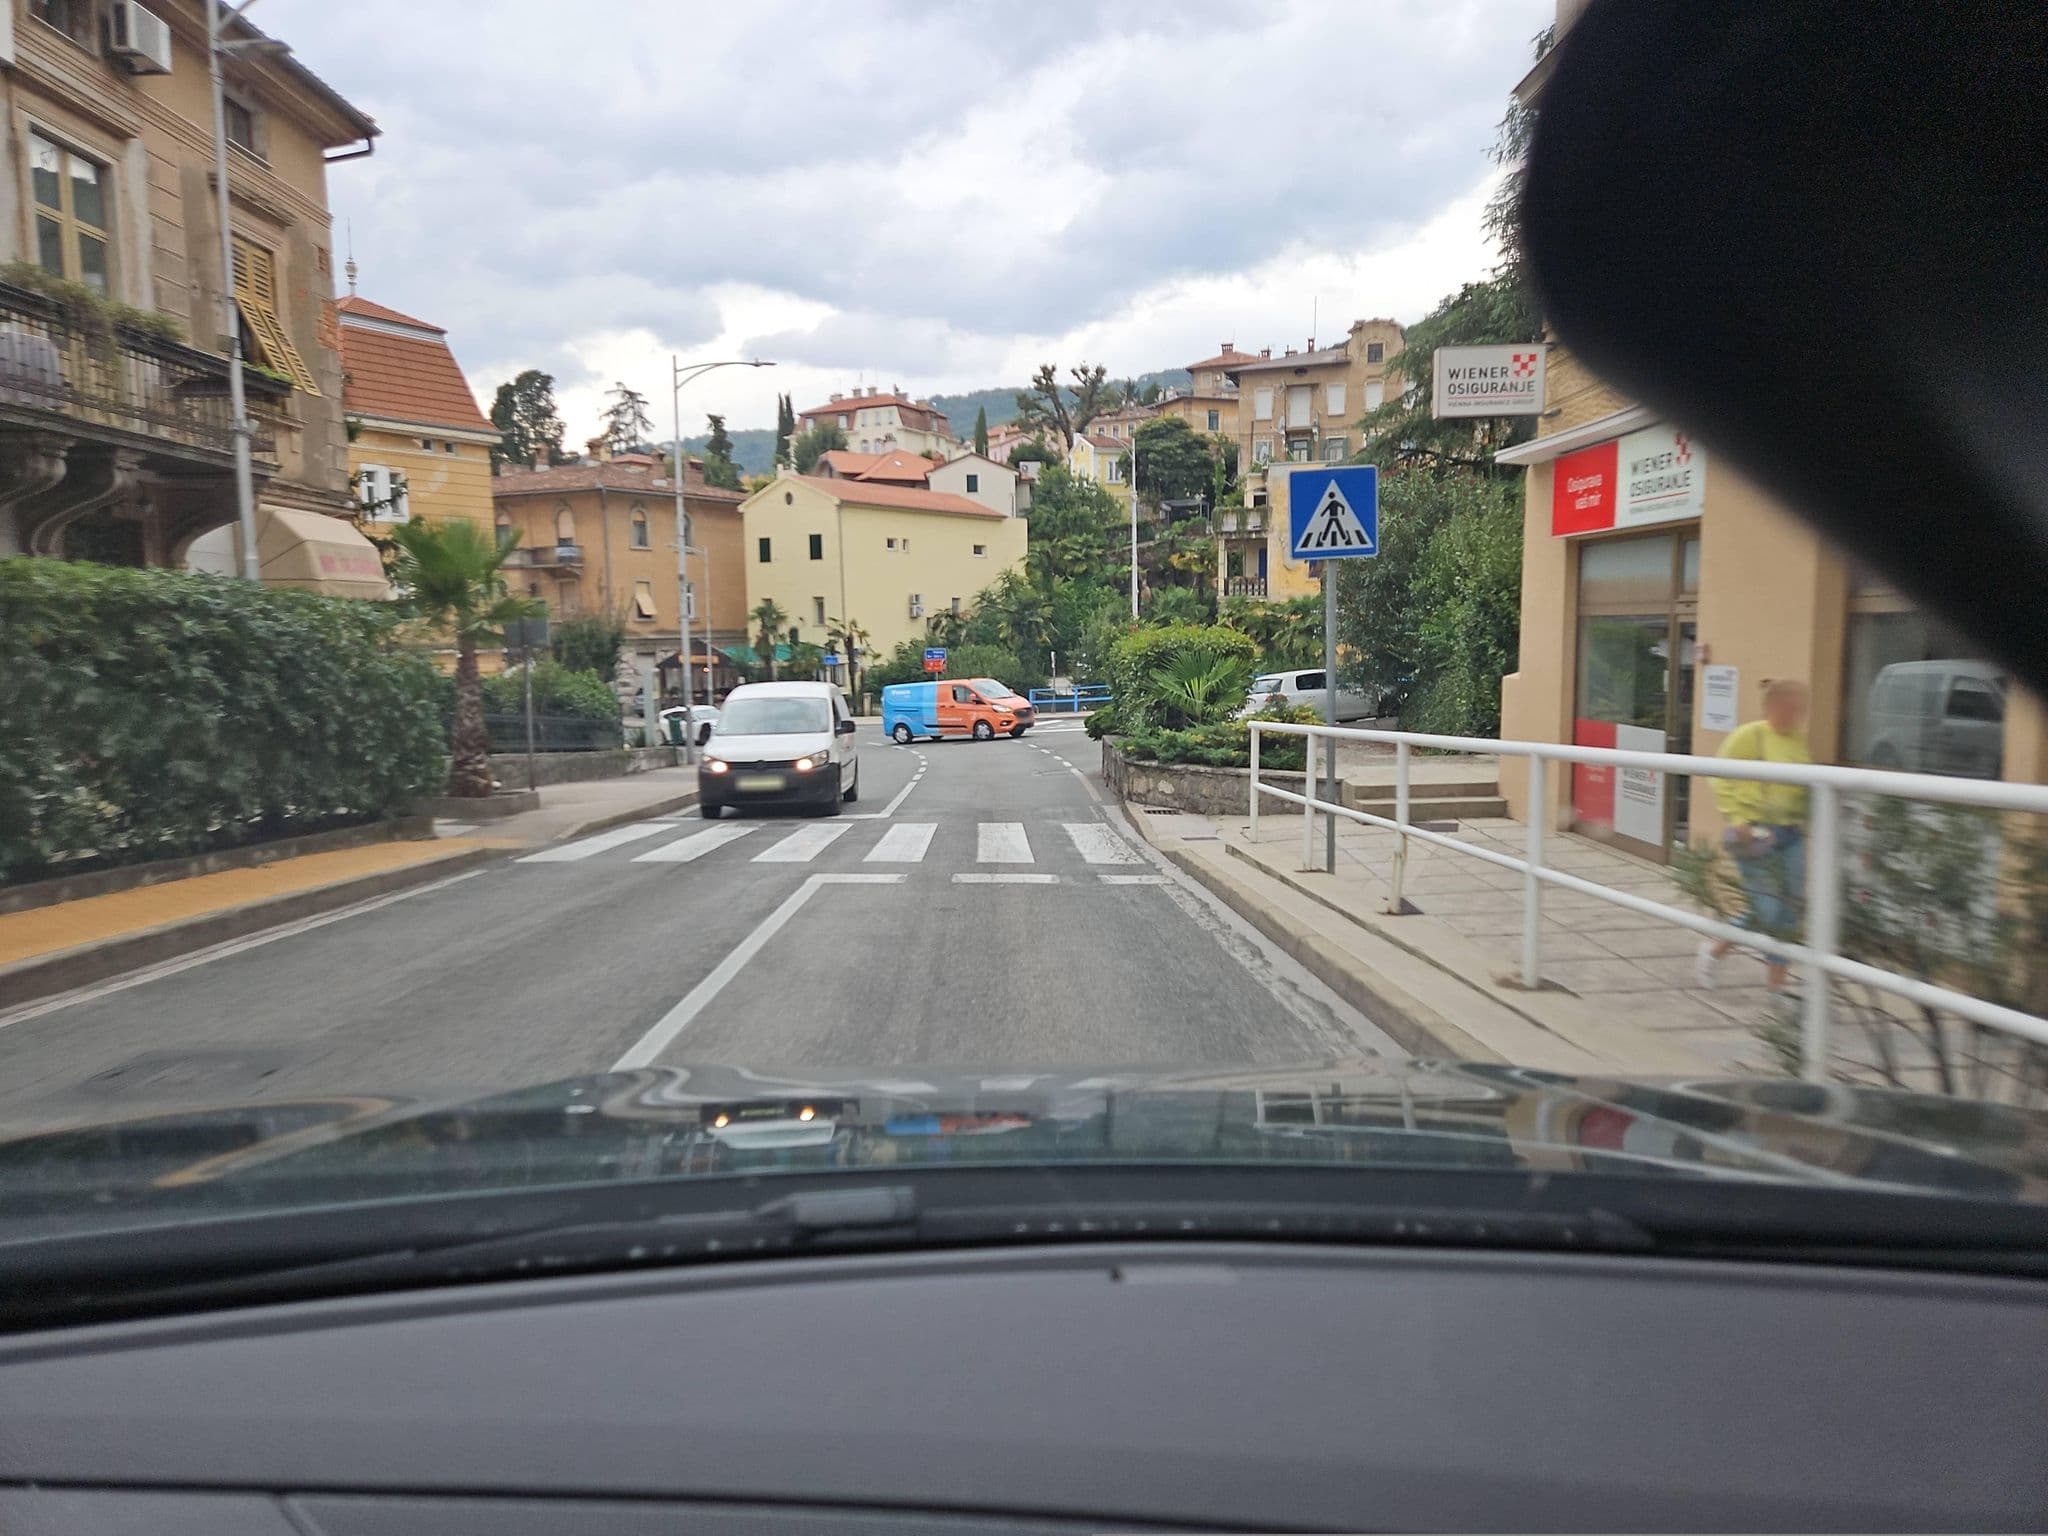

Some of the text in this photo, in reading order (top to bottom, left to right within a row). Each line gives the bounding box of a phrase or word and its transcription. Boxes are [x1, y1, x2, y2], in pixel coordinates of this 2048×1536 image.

[1448, 366, 1510, 380] WIENER
[1448, 380, 1536, 395] OSIGURANJE
[1630, 451, 1673, 476] WIENER
[1630, 469, 1691, 498] OSIGURANJE
